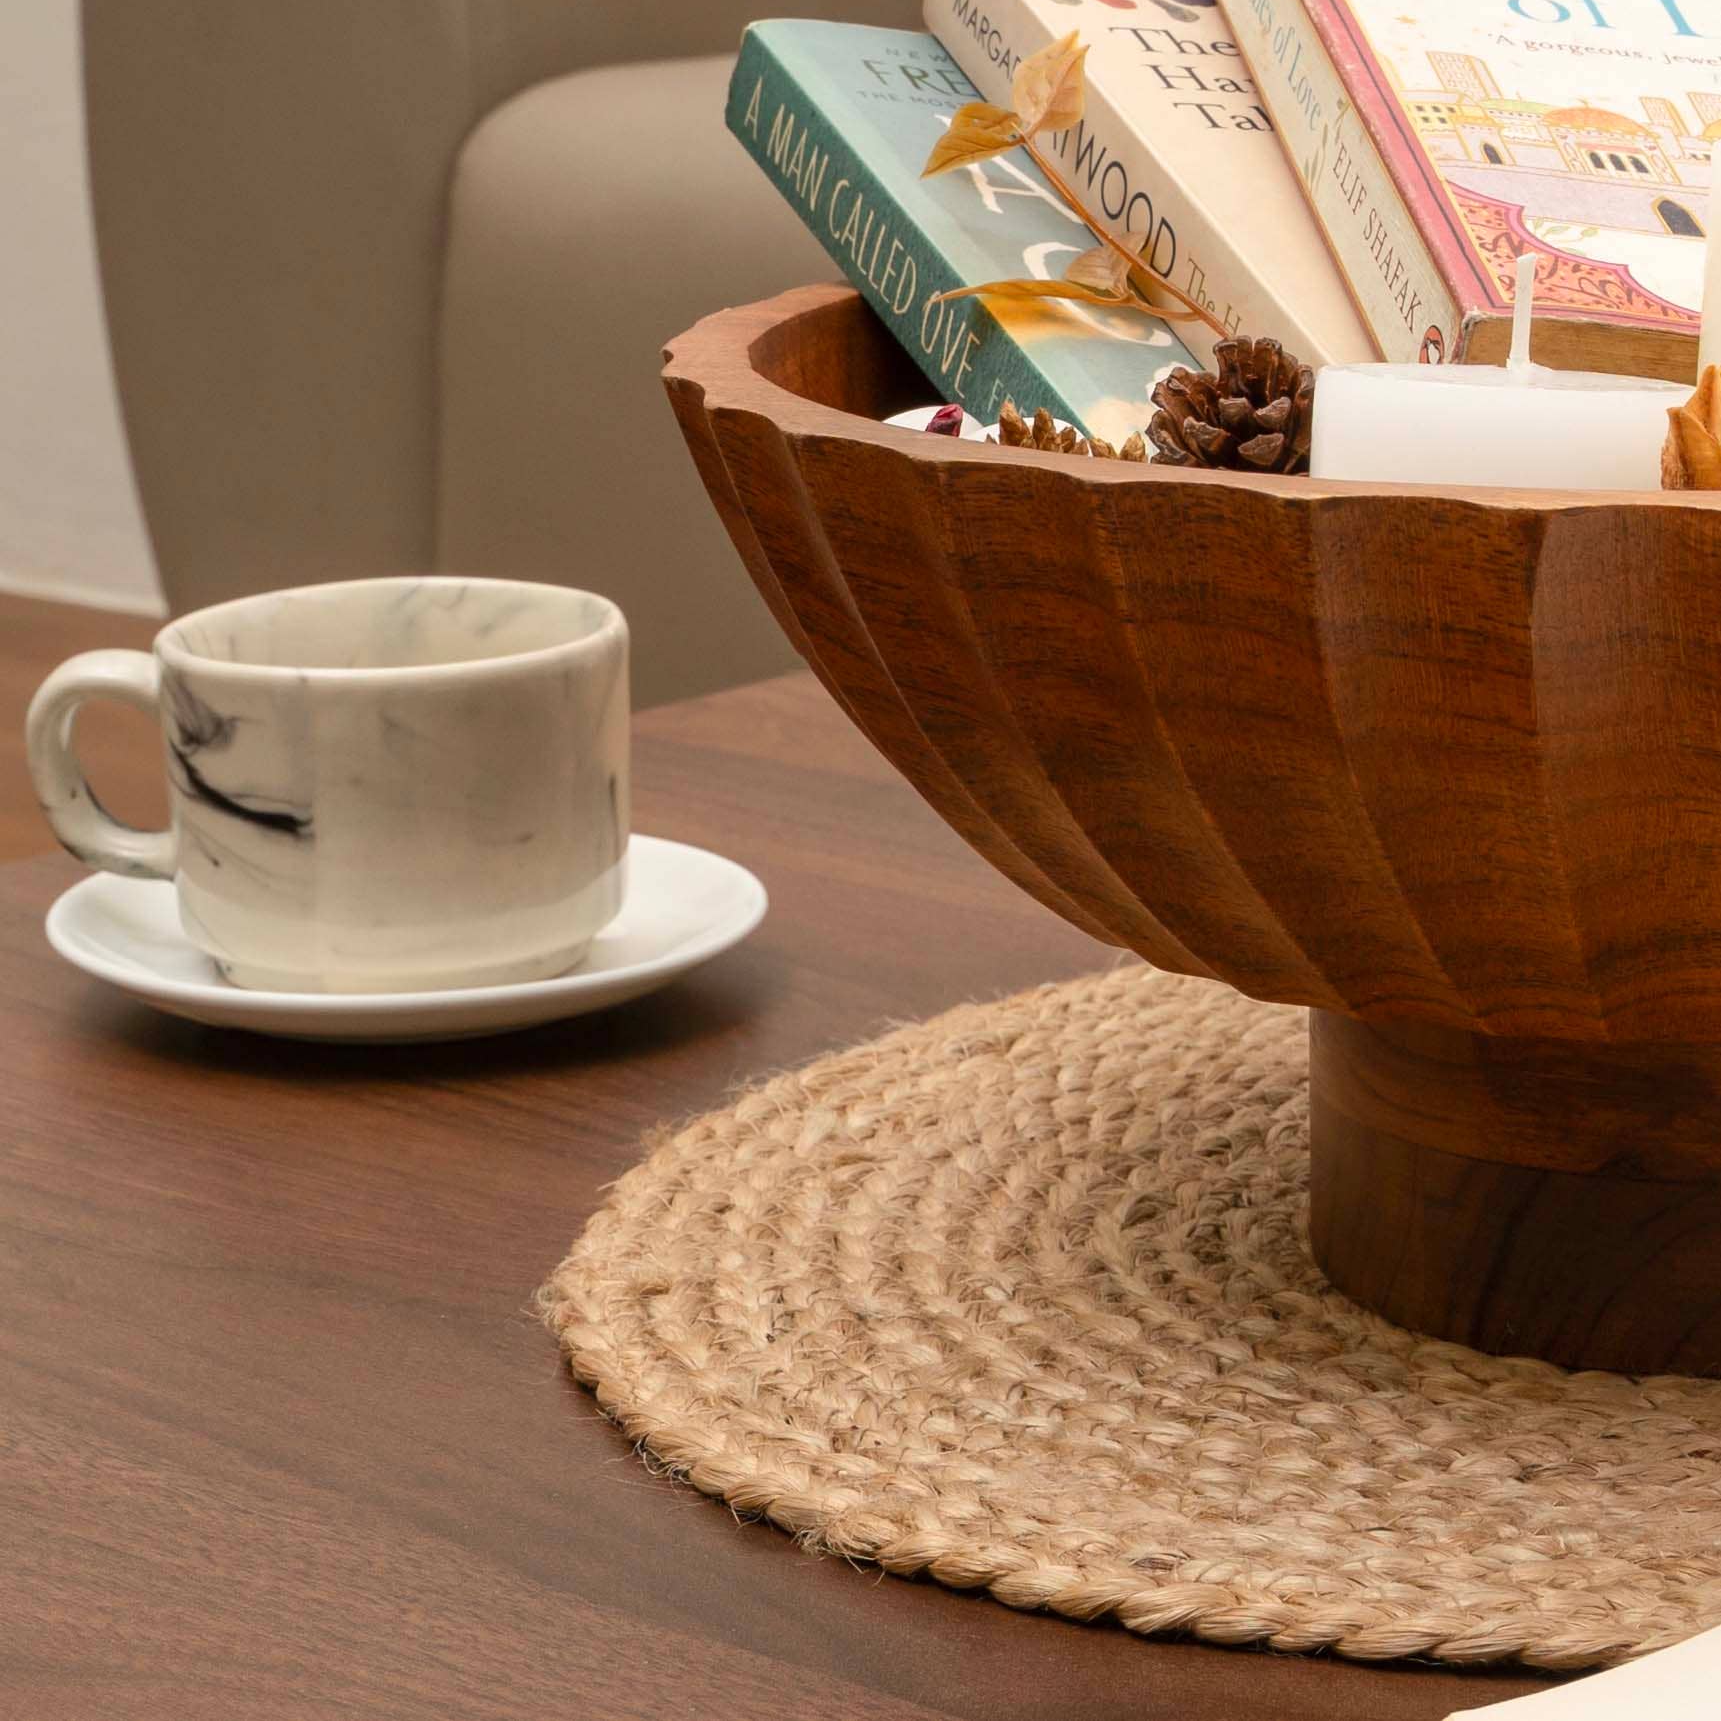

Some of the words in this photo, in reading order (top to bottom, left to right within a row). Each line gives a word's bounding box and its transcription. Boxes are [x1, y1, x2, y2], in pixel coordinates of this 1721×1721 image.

[1109, 26, 1241, 57] The
[1173, 101, 1277, 133] Tal
[744, 77, 763, 142] A
[767, 103, 828, 212] MAN
[829, 179, 917, 315] CALLED
[920, 290, 980, 398] OVE
[1053, 119, 1177, 279] WOOD
[1273, 25, 1295, 64] of
[1287, 42, 1321, 131] Love
[1333, 142, 1368, 215] ELIF
[1363, 207, 1422, 334] SHAFAK
